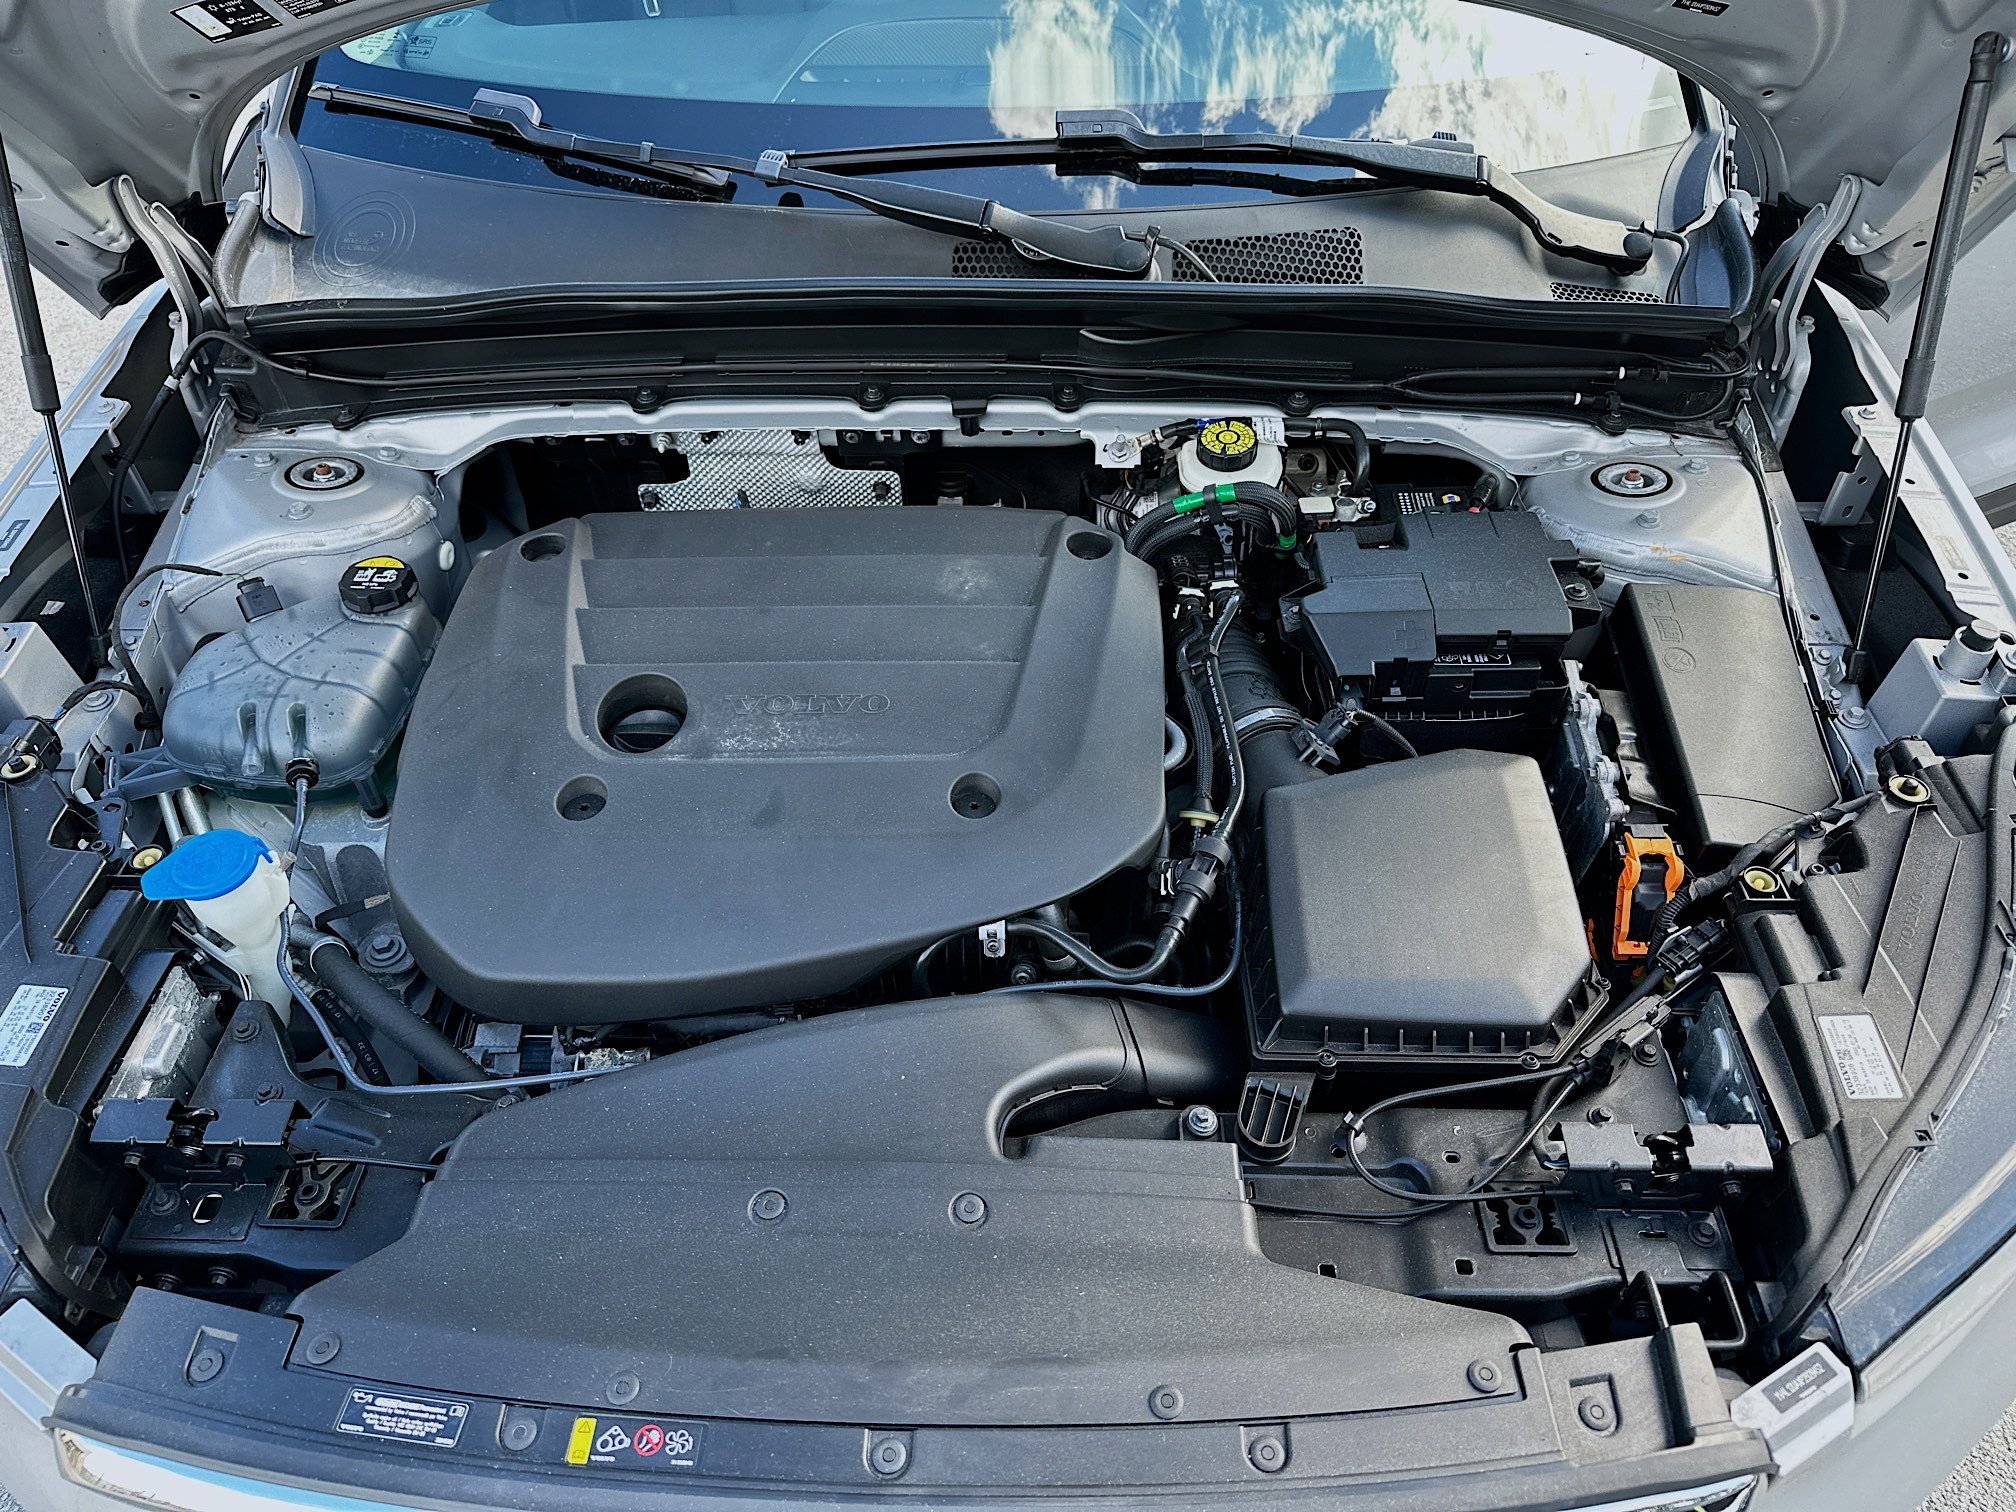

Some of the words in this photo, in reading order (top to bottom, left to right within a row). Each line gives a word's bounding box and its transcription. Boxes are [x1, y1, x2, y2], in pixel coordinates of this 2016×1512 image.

[725, 694, 891, 715] VOLVO
[41, 991, 65, 1021] VOLVO
[1837, 1062, 1856, 1095] VOLVO
